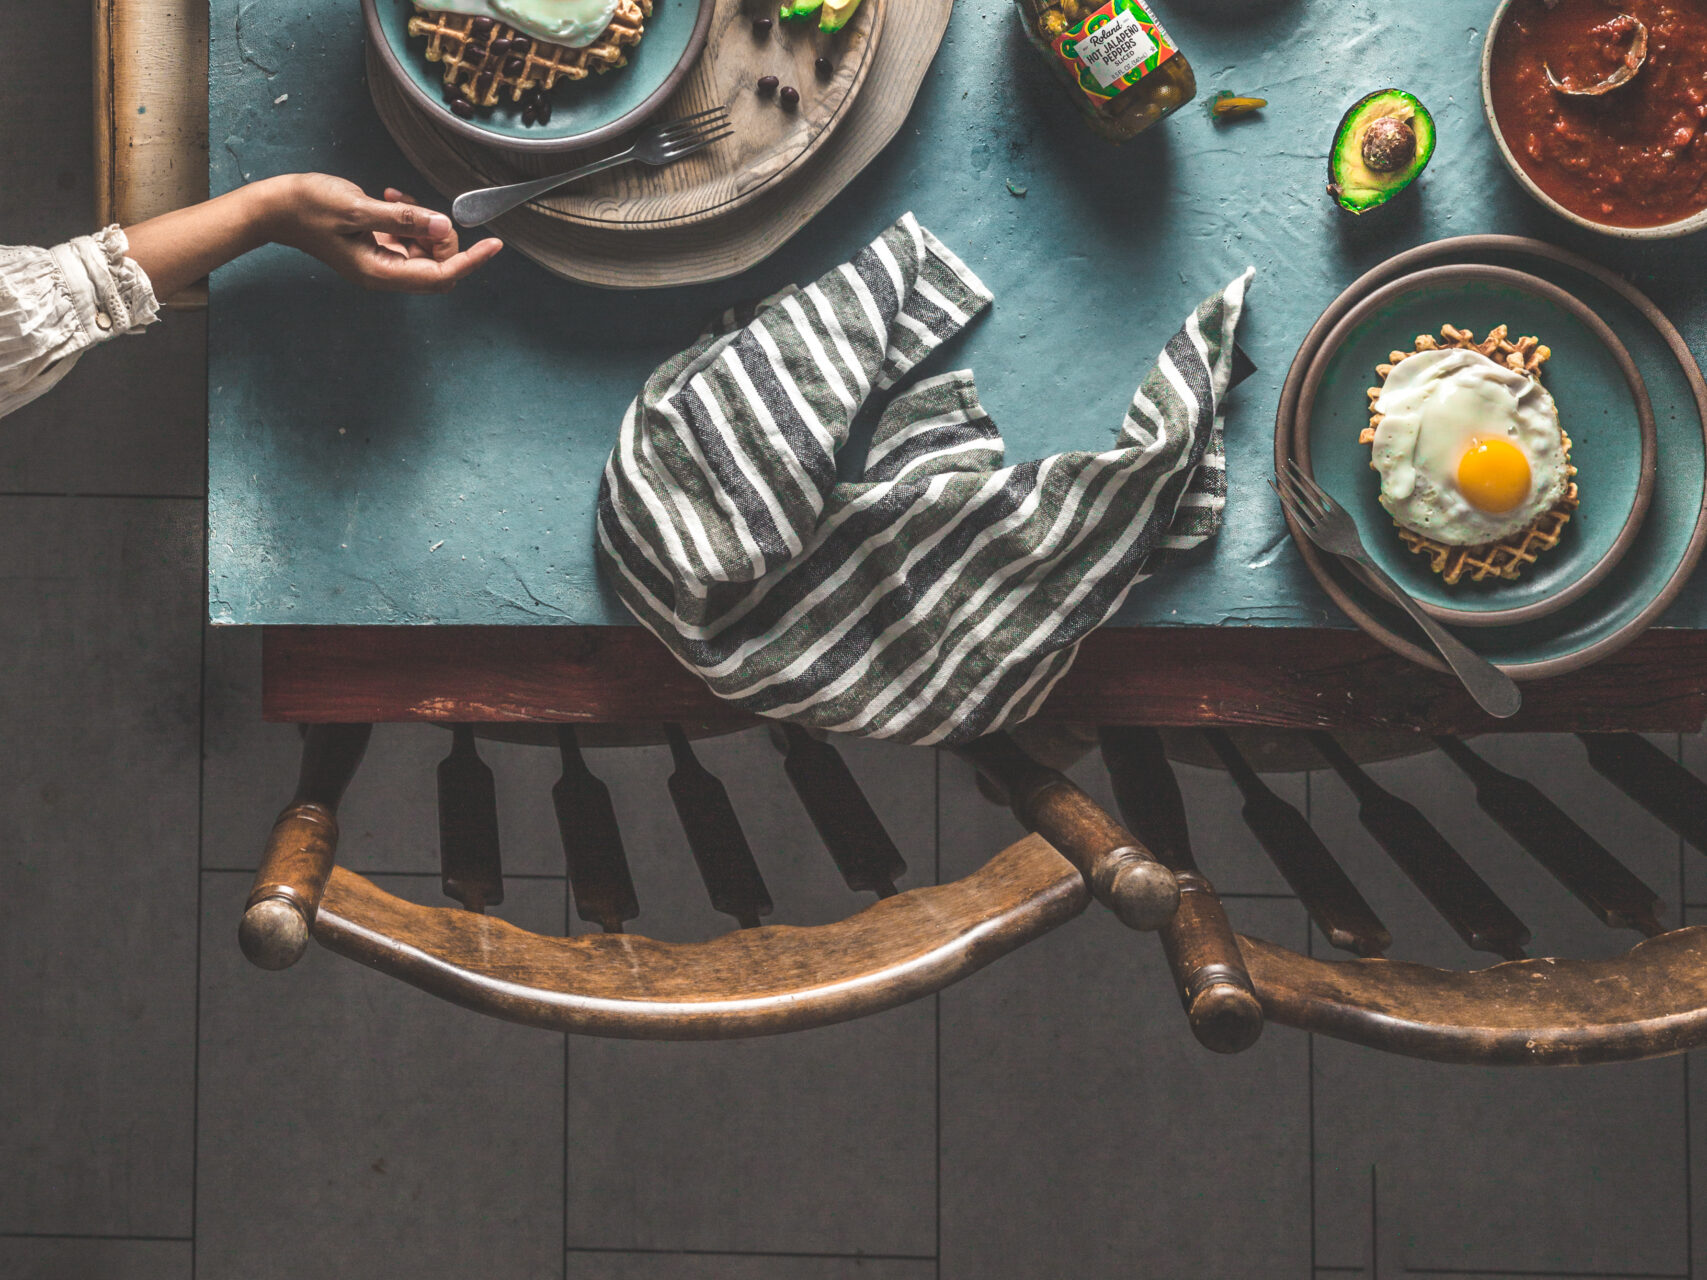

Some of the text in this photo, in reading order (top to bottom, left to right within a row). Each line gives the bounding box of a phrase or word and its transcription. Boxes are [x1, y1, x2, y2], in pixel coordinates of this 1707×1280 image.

[1086, 48, 1104, 65] HOT
[1103, 24, 1139, 54] JALAPEÑO
[1089, 20, 1123, 47] Roland
[1102, 38, 1137, 66] PEPPERS
[1114, 50, 1135, 66] SLICED
